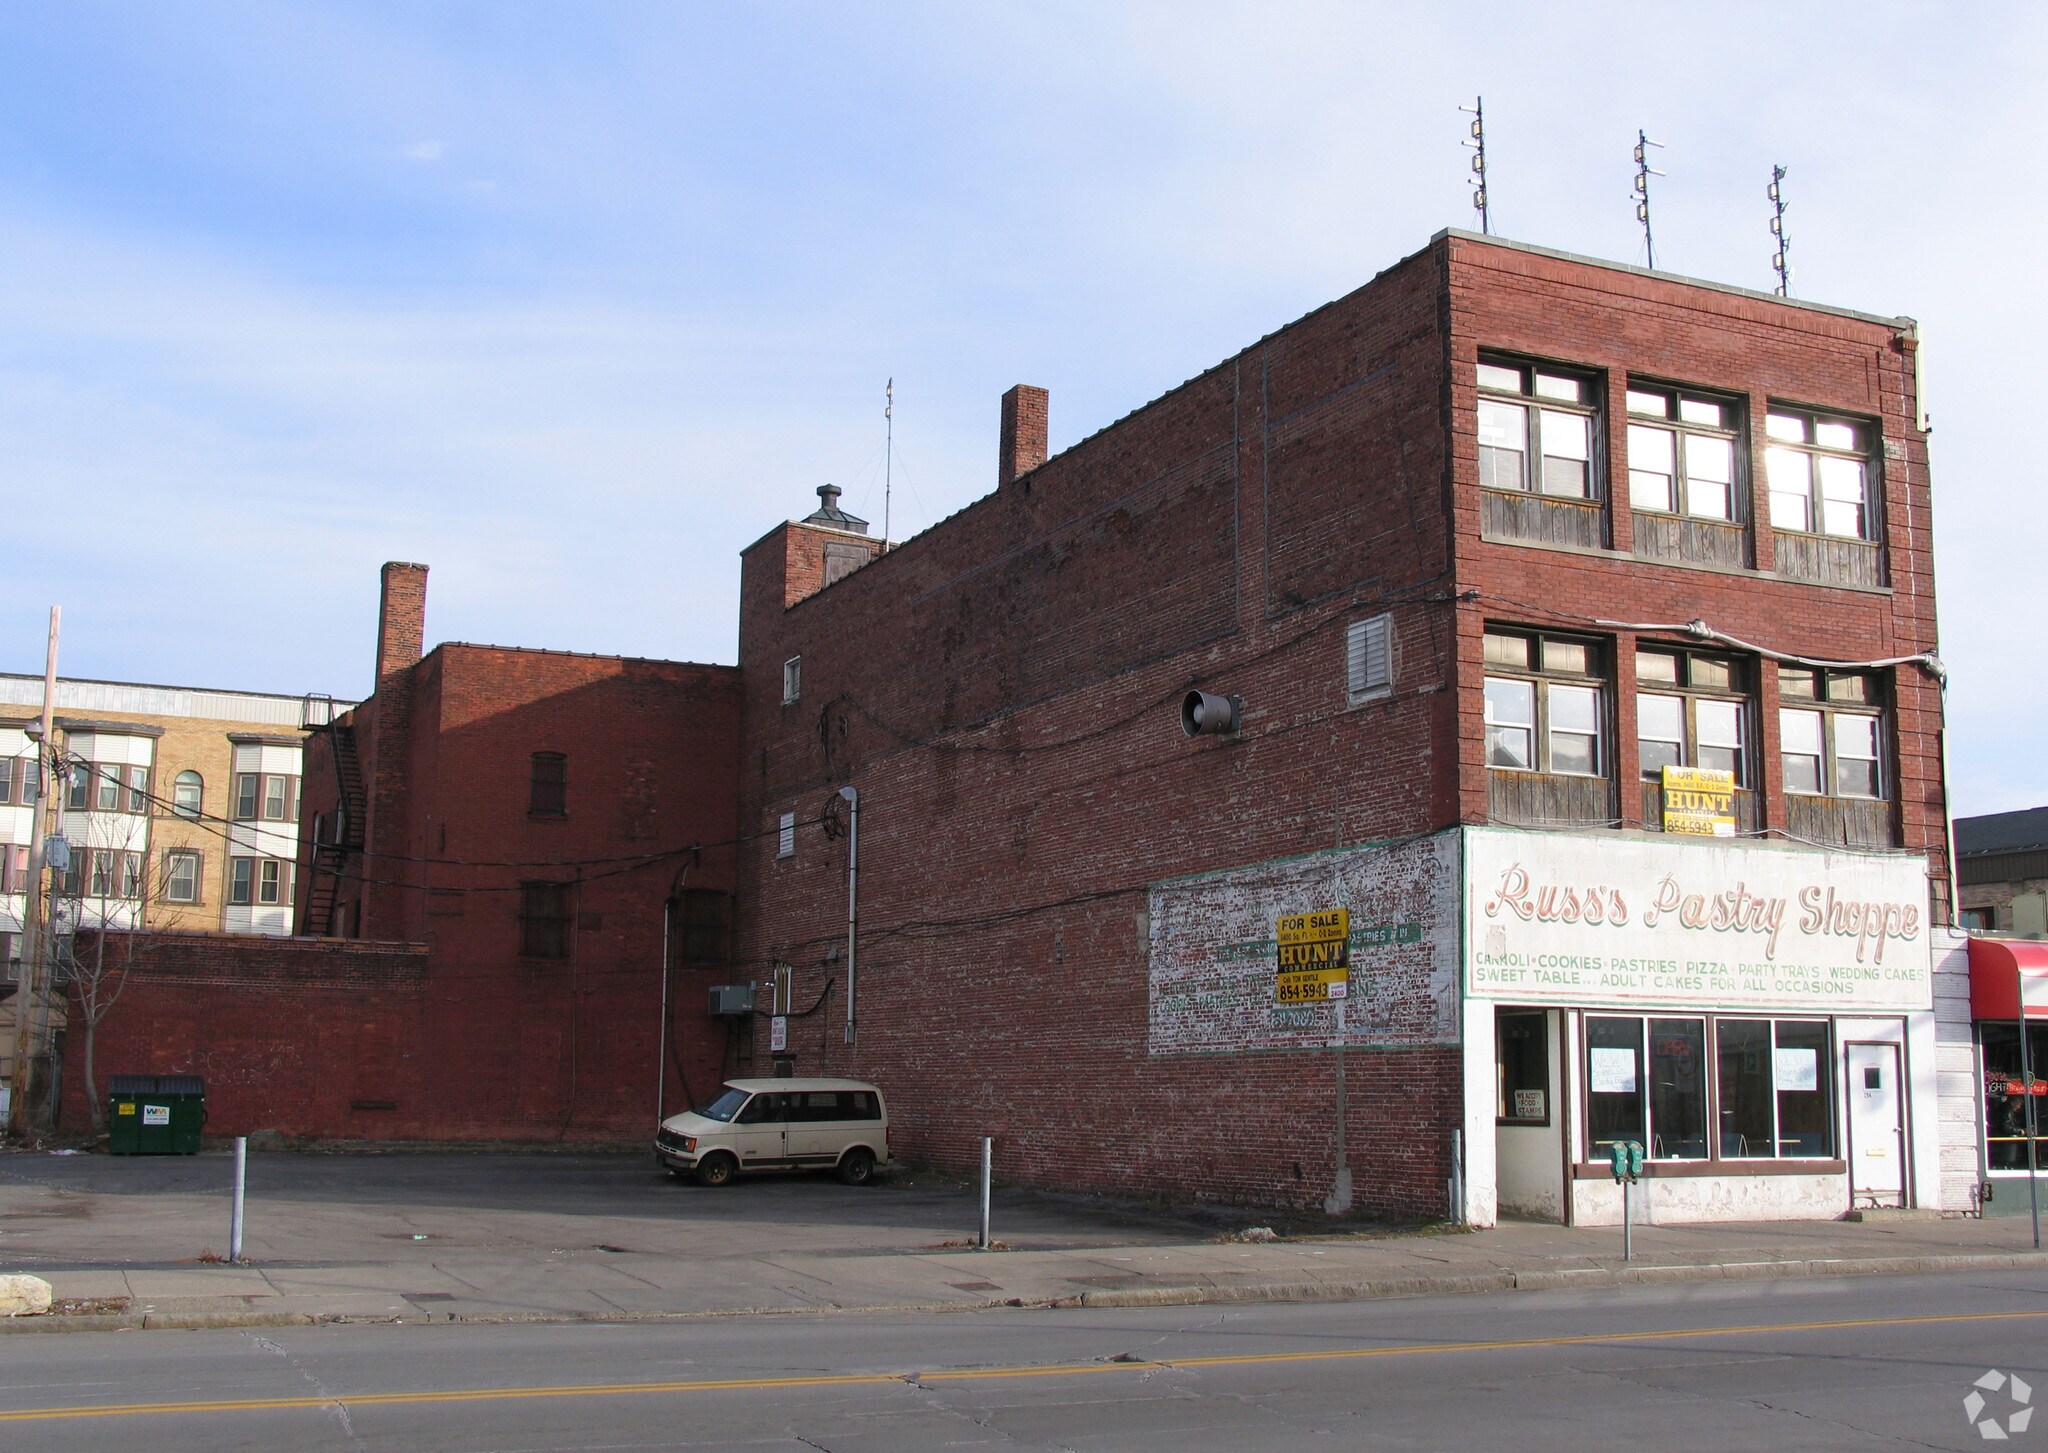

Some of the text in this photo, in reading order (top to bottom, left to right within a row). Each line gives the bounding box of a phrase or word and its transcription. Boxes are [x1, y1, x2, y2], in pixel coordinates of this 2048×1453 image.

[1700, 771, 1728, 783] SALE
[1667, 790, 1731, 811] HUNT
[1282, 914, 1339, 931] FOR SALE
[1485, 862, 1919, 965] Russ's Pastry Shoppe
[1280, 941, 1344, 965] HUNT
[1284, 960, 1338, 972] COMMERCIAL
[1538, 955, 1602, 970] COOKIES
[1611, 958, 1677, 973] PASTRIES
[1687, 961, 1728, 975] PIZZA
[1739, 963, 1776, 977] PARTY
[1781, 965, 1820, 978] TRAYS
[1829, 967, 1880, 980] WEDDING
[1885, 968, 1925, 982] CAKES
[1476, 967, 1527, 982] SWEET
[1600, 973, 1647, 987] ADULT
[1654, 975, 1703, 990] CAKES
[1710, 978, 1736, 991] FOR
[1743, 979, 1766, 991] ALL
[1775, 981, 1854, 994] OCCASIONS
[1280, 982, 1328, 1000] 854-5943
[1657, 1039, 1690, 1056] OPEN
